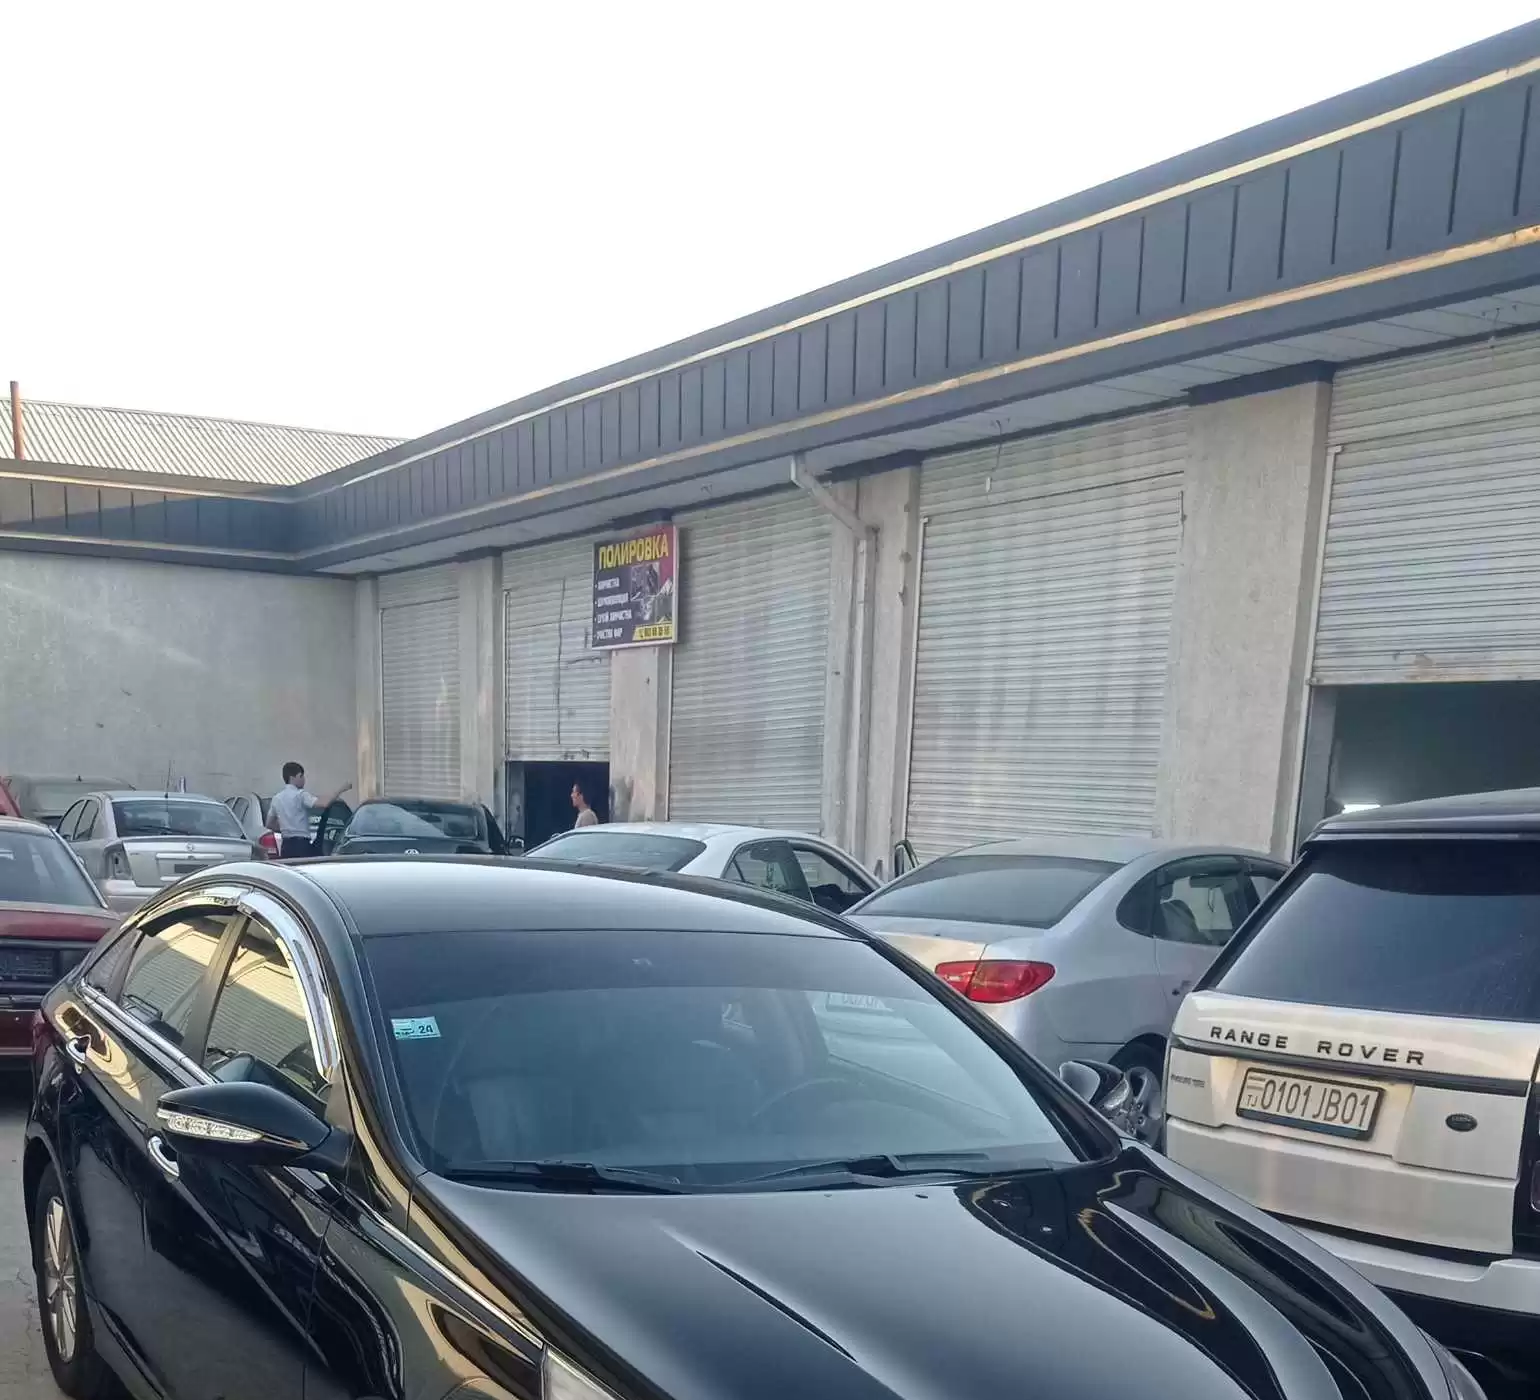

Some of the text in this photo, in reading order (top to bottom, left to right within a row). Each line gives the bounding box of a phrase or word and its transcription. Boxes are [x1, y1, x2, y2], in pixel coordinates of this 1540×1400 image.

[599, 533, 669, 569] ПОЛИРОВКА
[1210, 1026, 1425, 1066] RANGE ROVER
[1261, 1078, 1371, 1128] 0101JB01
